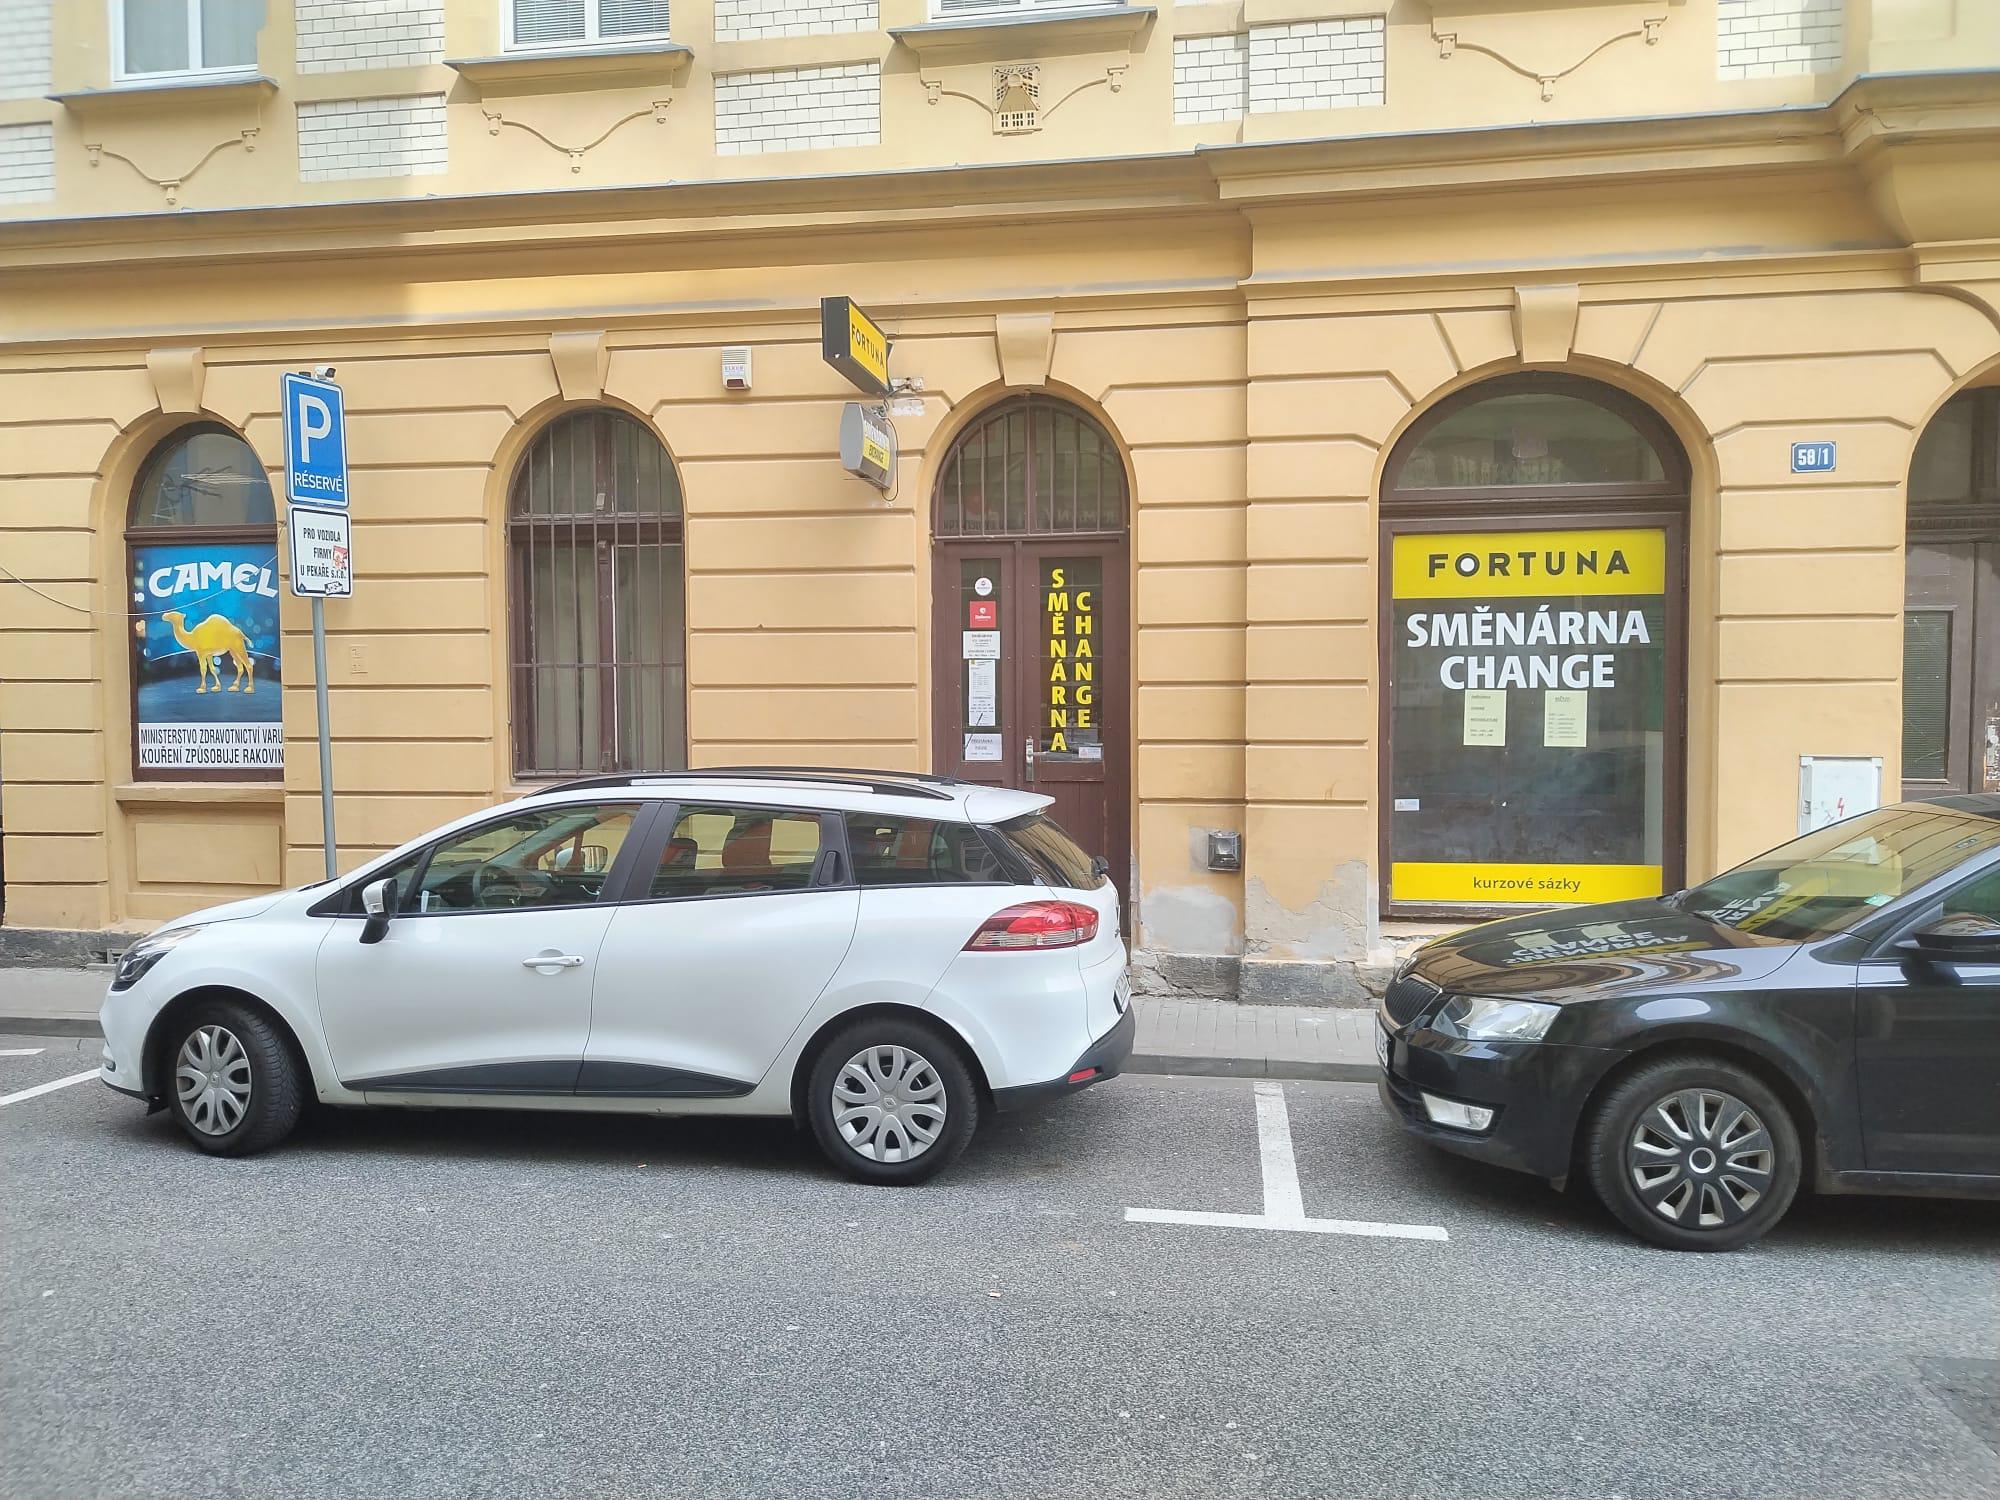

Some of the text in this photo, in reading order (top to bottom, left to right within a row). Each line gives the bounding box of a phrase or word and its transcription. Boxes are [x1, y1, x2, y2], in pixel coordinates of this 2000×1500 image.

[851, 323, 885, 368] FORTUNA
[299, 393, 331, 463] P
[1798, 447, 1829, 466] 58/1
[294, 470, 344, 493] RÉSERVÉ
[303, 527, 341, 542] PRO VOZIDLA
[313, 547, 332, 560] FIRMY
[1428, 550, 1631, 578] FORTUNA
[149, 561, 278, 598] CAMEL
[300, 564, 305, 576] U
[306, 562, 330, 578] PEKAŘE
[1406, 604, 1650, 648] SMĚNÁRNA
[1047, 568, 1069, 751] SMĚNÁRNA
[1075, 591, 1092, 728] CHANGE
[1440, 654, 1616, 690] CHANGE
[141, 728, 197, 744] MINISTERSTVO
[199, 725, 260, 744] ZDRAVOTNICTVÍ
[141, 745, 183, 763] KOUŘENÍ
[185, 745, 239, 764] ZPŮSOBUJE
[1473, 876, 1581, 892] kurzové sázky
